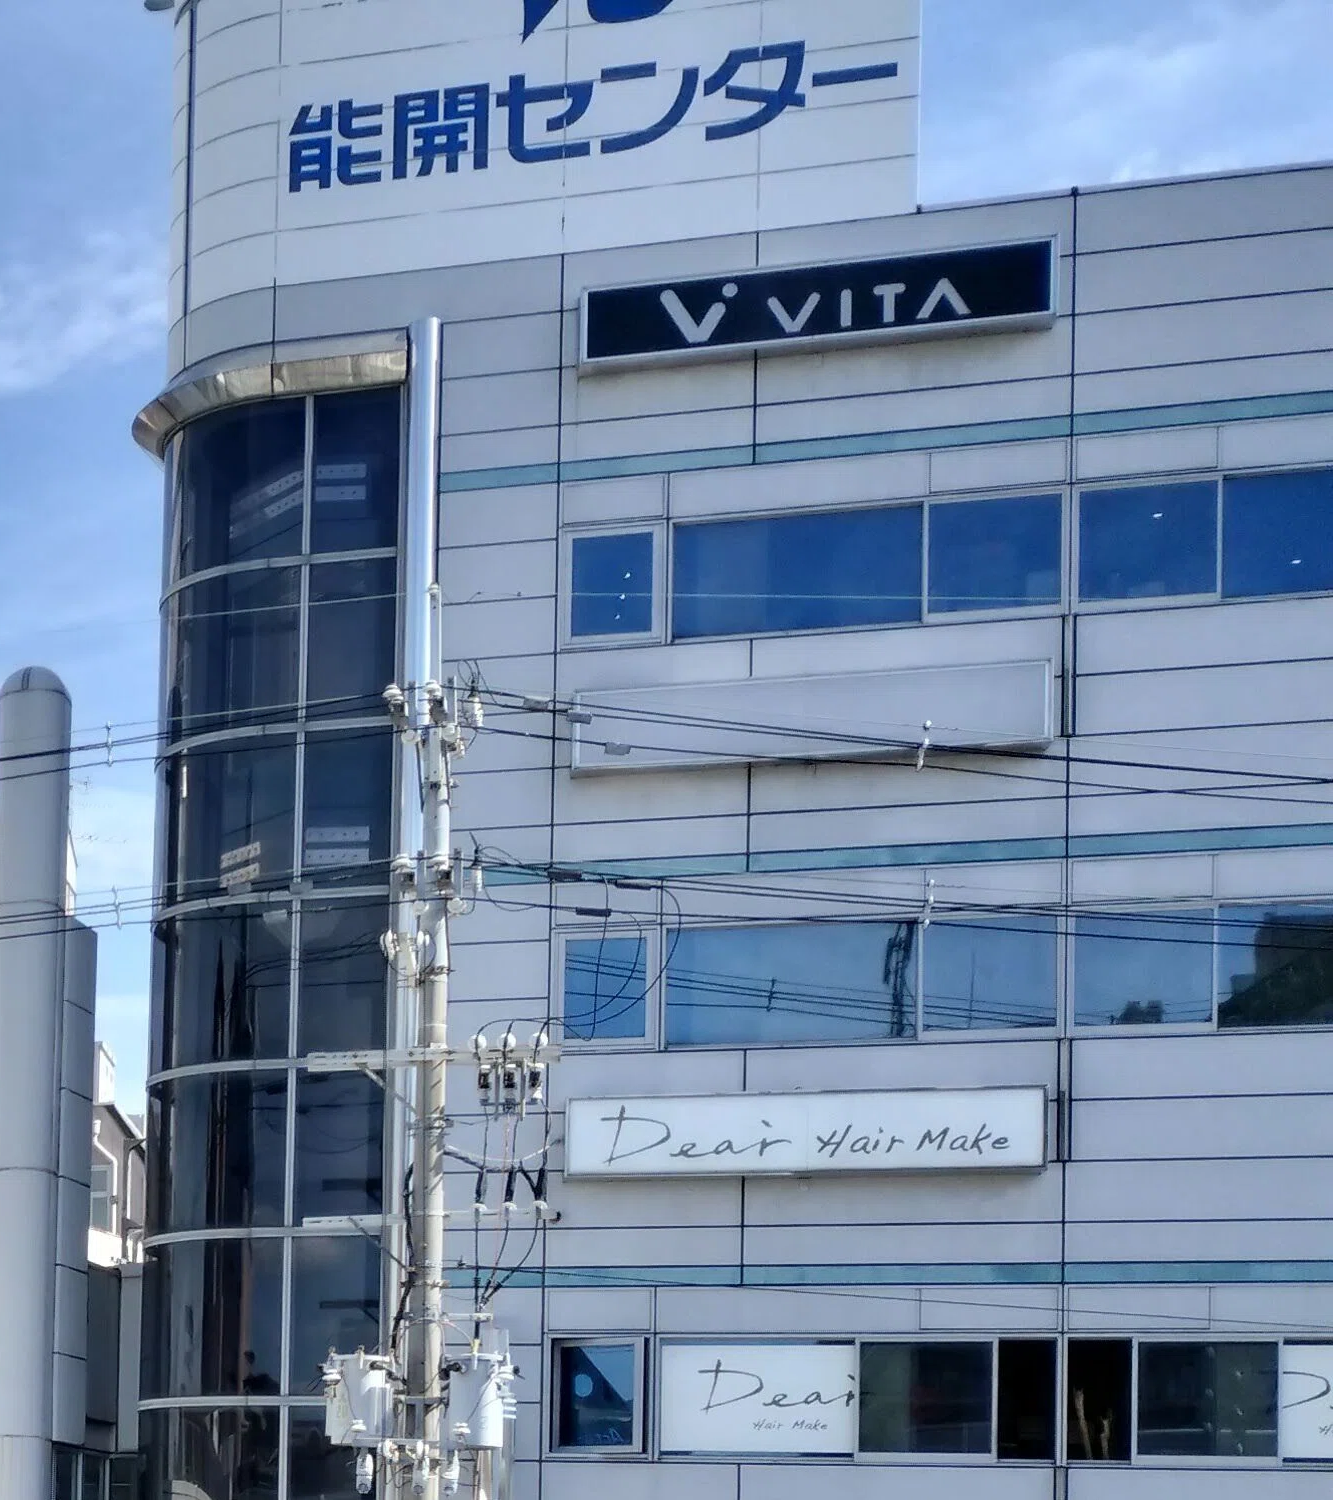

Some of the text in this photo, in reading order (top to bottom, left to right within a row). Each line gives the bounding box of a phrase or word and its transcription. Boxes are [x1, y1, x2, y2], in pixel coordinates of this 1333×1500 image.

[288, 39, 899, 193] 能開センター
[767, 277, 971, 333] VITA
[600, 1104, 1010, 1167] Dear Hair Make
[791, 1419, 829, 1431] Make
